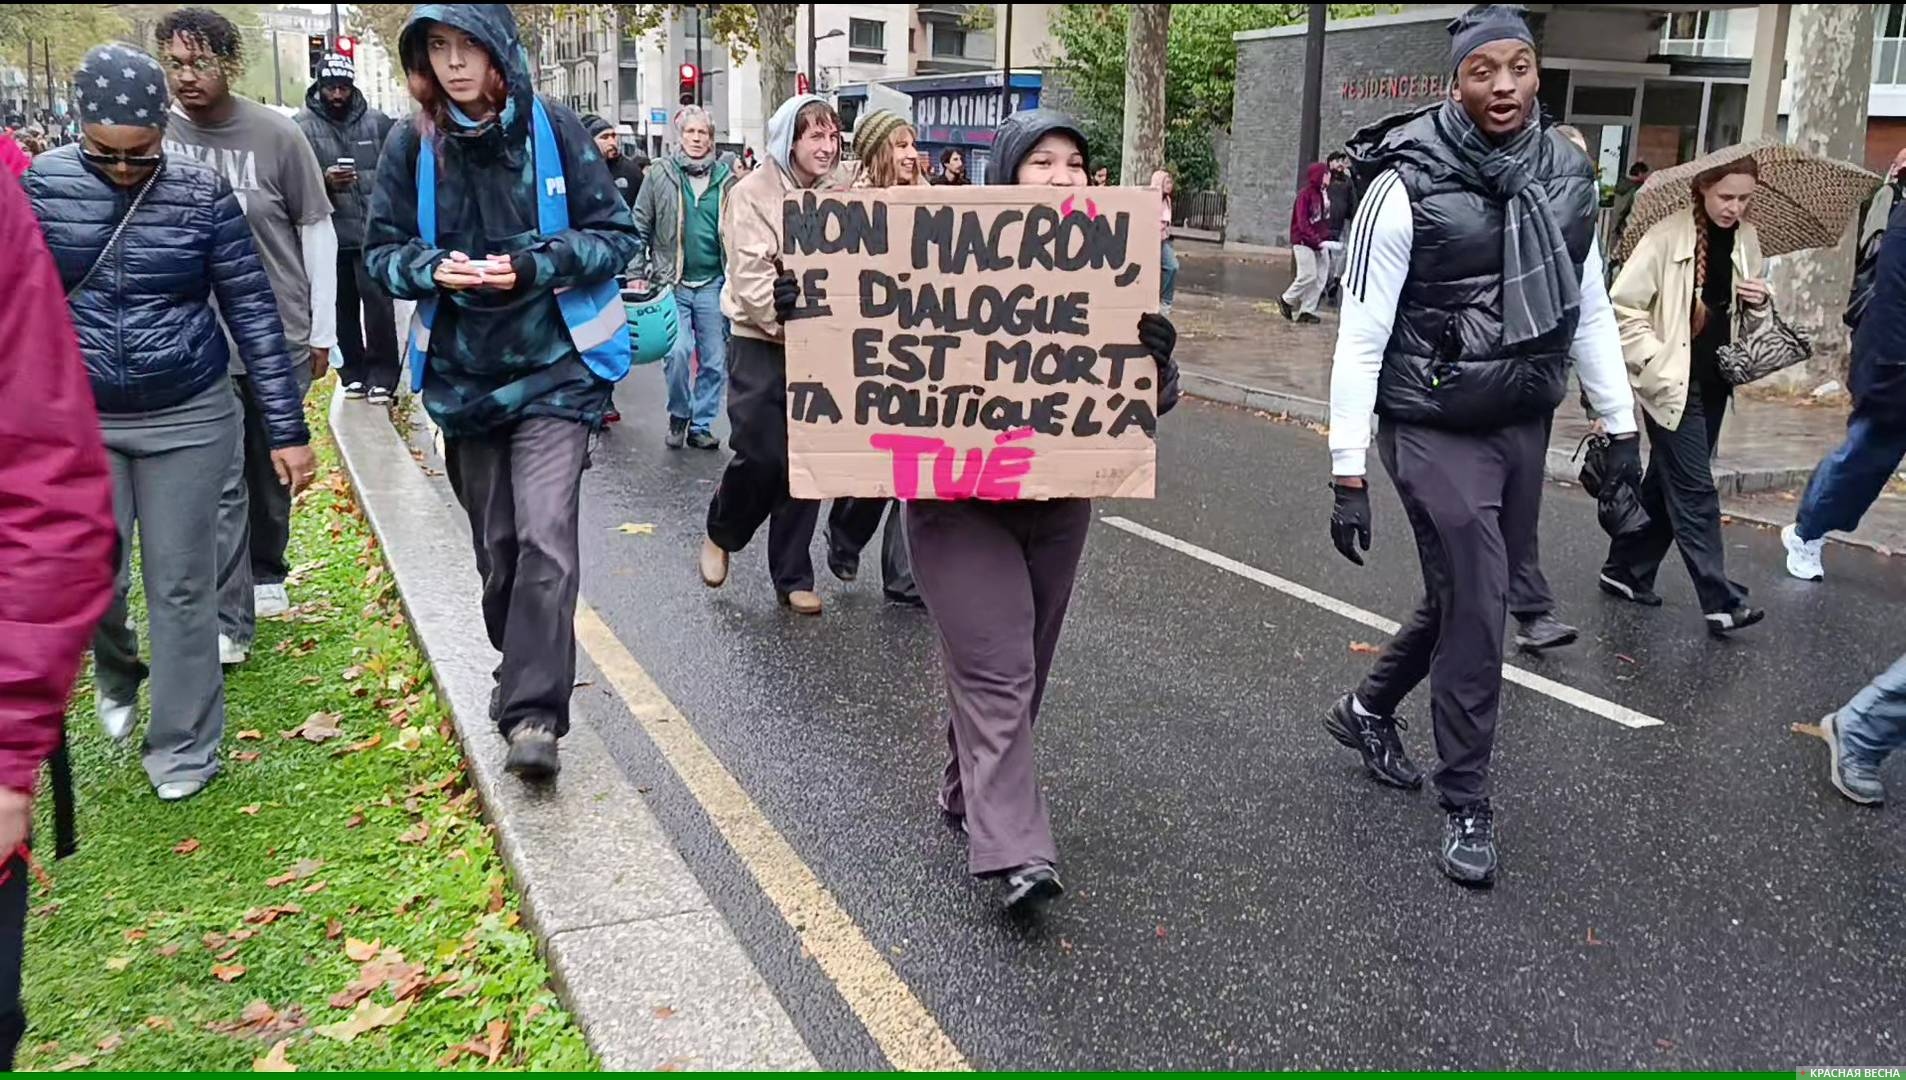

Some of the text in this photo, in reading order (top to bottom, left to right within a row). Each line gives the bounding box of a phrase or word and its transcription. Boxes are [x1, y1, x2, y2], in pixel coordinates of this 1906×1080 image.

[783, 191, 889, 256] NON
[852, 328, 1154, 391] EST MORT.
[787, 382, 843, 425] TA
[869, 426, 1037, 501] TUÉ
